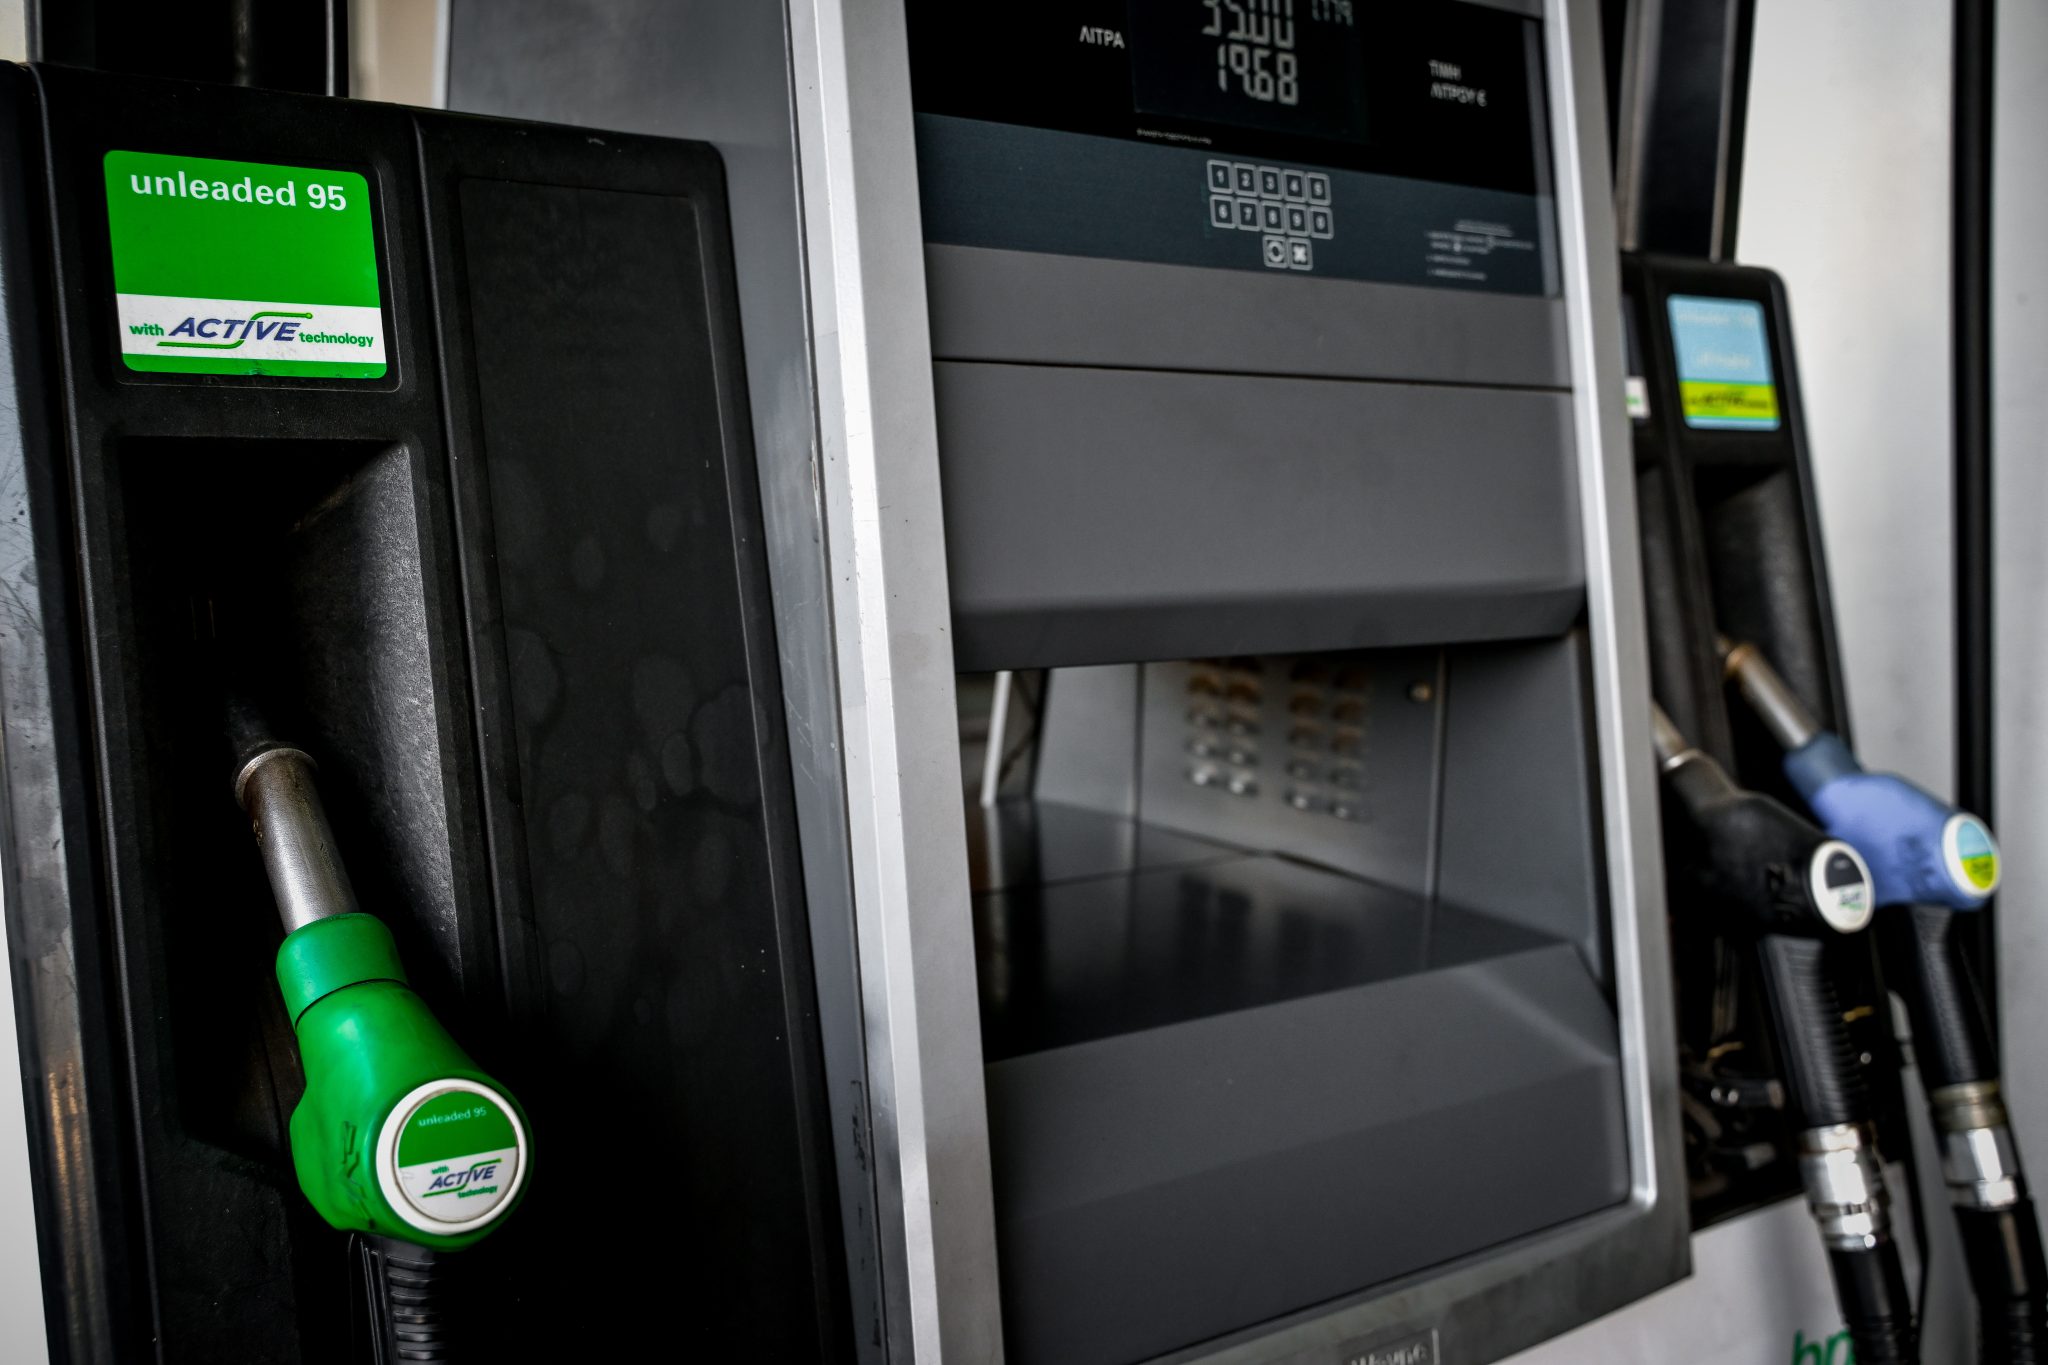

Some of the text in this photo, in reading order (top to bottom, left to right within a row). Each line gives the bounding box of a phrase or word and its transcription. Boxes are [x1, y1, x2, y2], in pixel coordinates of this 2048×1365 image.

[130, 170, 347, 211] unleaded 95
[129, 316, 374, 348] with ACTIVE technology
[417, 1106, 487, 1127] unleaded 95
[429, 1165, 496, 1191] ACTIVE
